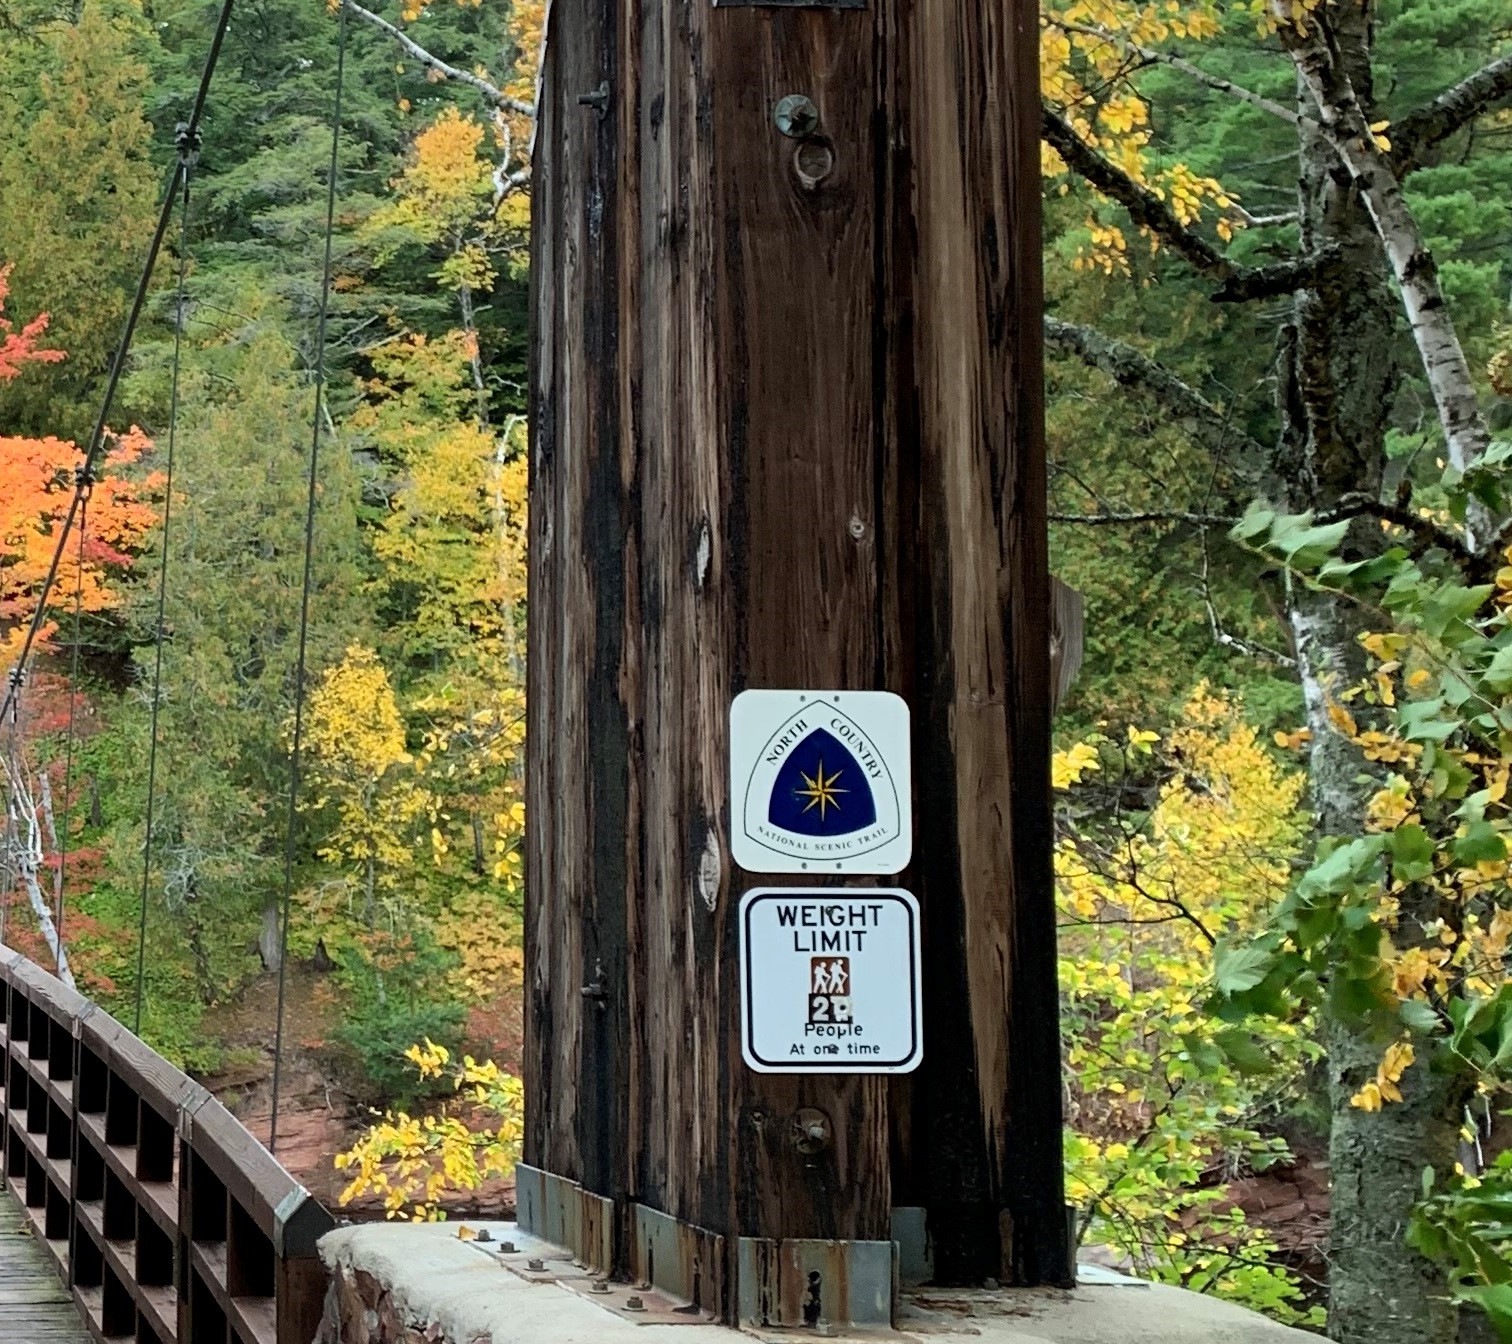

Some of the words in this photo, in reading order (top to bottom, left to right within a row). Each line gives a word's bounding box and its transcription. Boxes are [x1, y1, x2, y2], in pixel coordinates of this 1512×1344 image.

[766, 719, 809, 766] NORTH
[830, 718, 883, 779] COUNTRY
[758, 825, 809, 850] NATIONAL
[814, 840, 853, 851] SCENIC
[857, 827, 888, 846] TRAIL
[776, 905, 884, 927] WEIGHT
[794, 930, 868, 952] LIMIT
[804, 1023, 864, 1039] People
[789, 1043, 805, 1055] At
[847, 1042, 881, 1055] time
